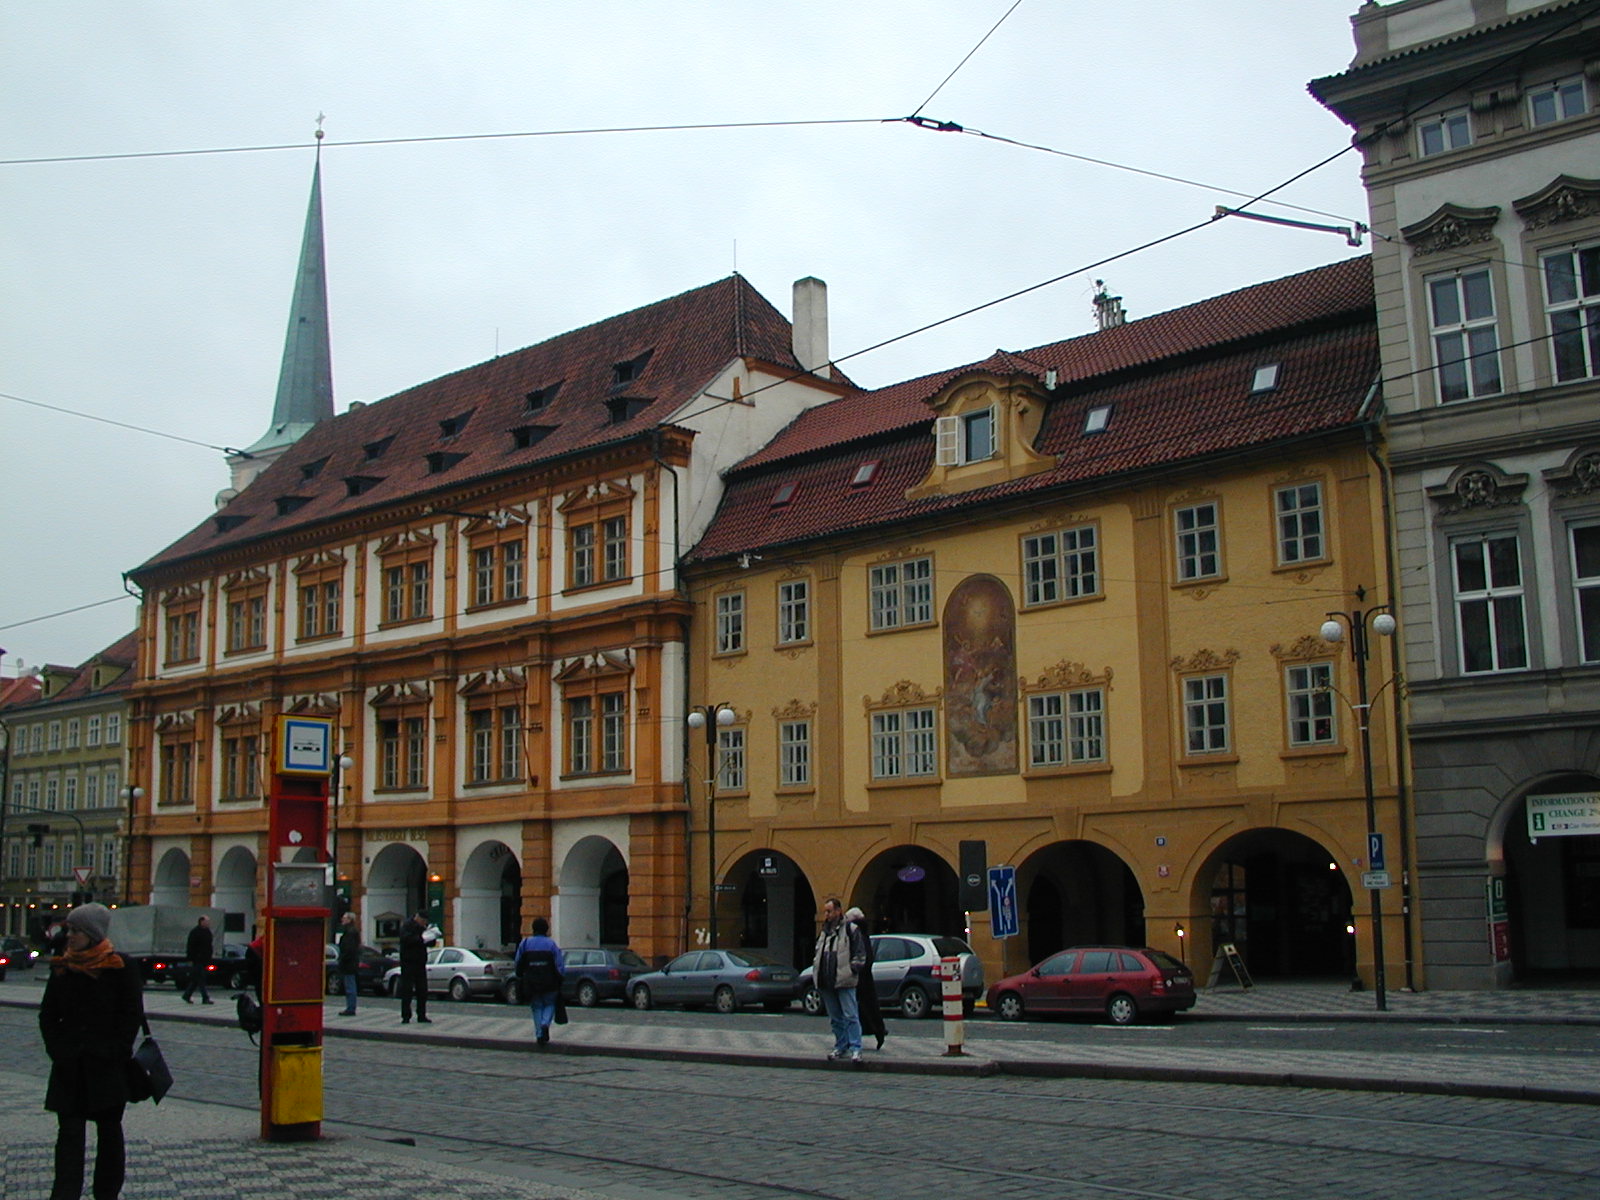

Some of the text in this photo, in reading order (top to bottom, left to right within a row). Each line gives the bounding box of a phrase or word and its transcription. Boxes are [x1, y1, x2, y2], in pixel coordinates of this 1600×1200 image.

[1531, 796, 1585, 807] INFORMATION
[1549, 808, 1586, 817] CHANGE
[1371, 836, 1379, 857] P
